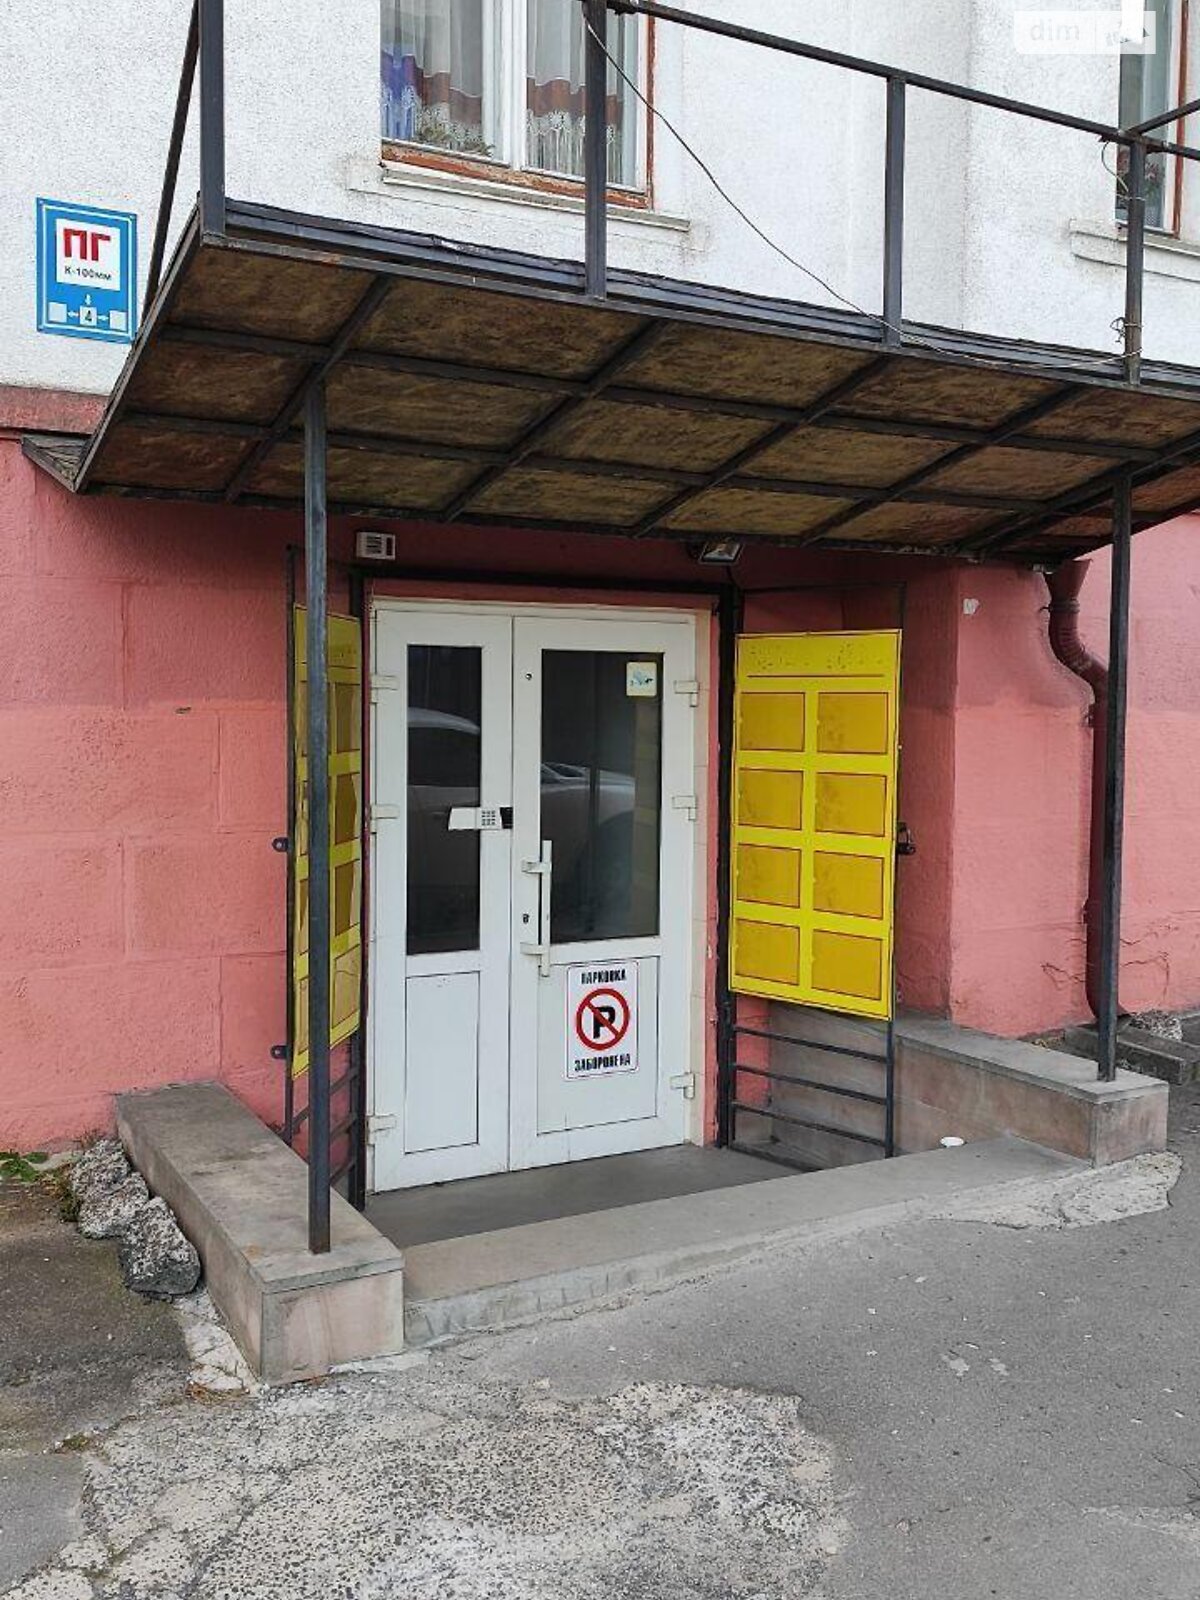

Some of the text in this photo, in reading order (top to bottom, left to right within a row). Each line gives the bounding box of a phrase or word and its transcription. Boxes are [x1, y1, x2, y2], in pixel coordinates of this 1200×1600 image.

[63, 228, 111, 261] ПГ
[581, 969, 626, 984] ПАРКОВКА
[574, 1053, 631, 1072] ЗАБОРОНЕНА
